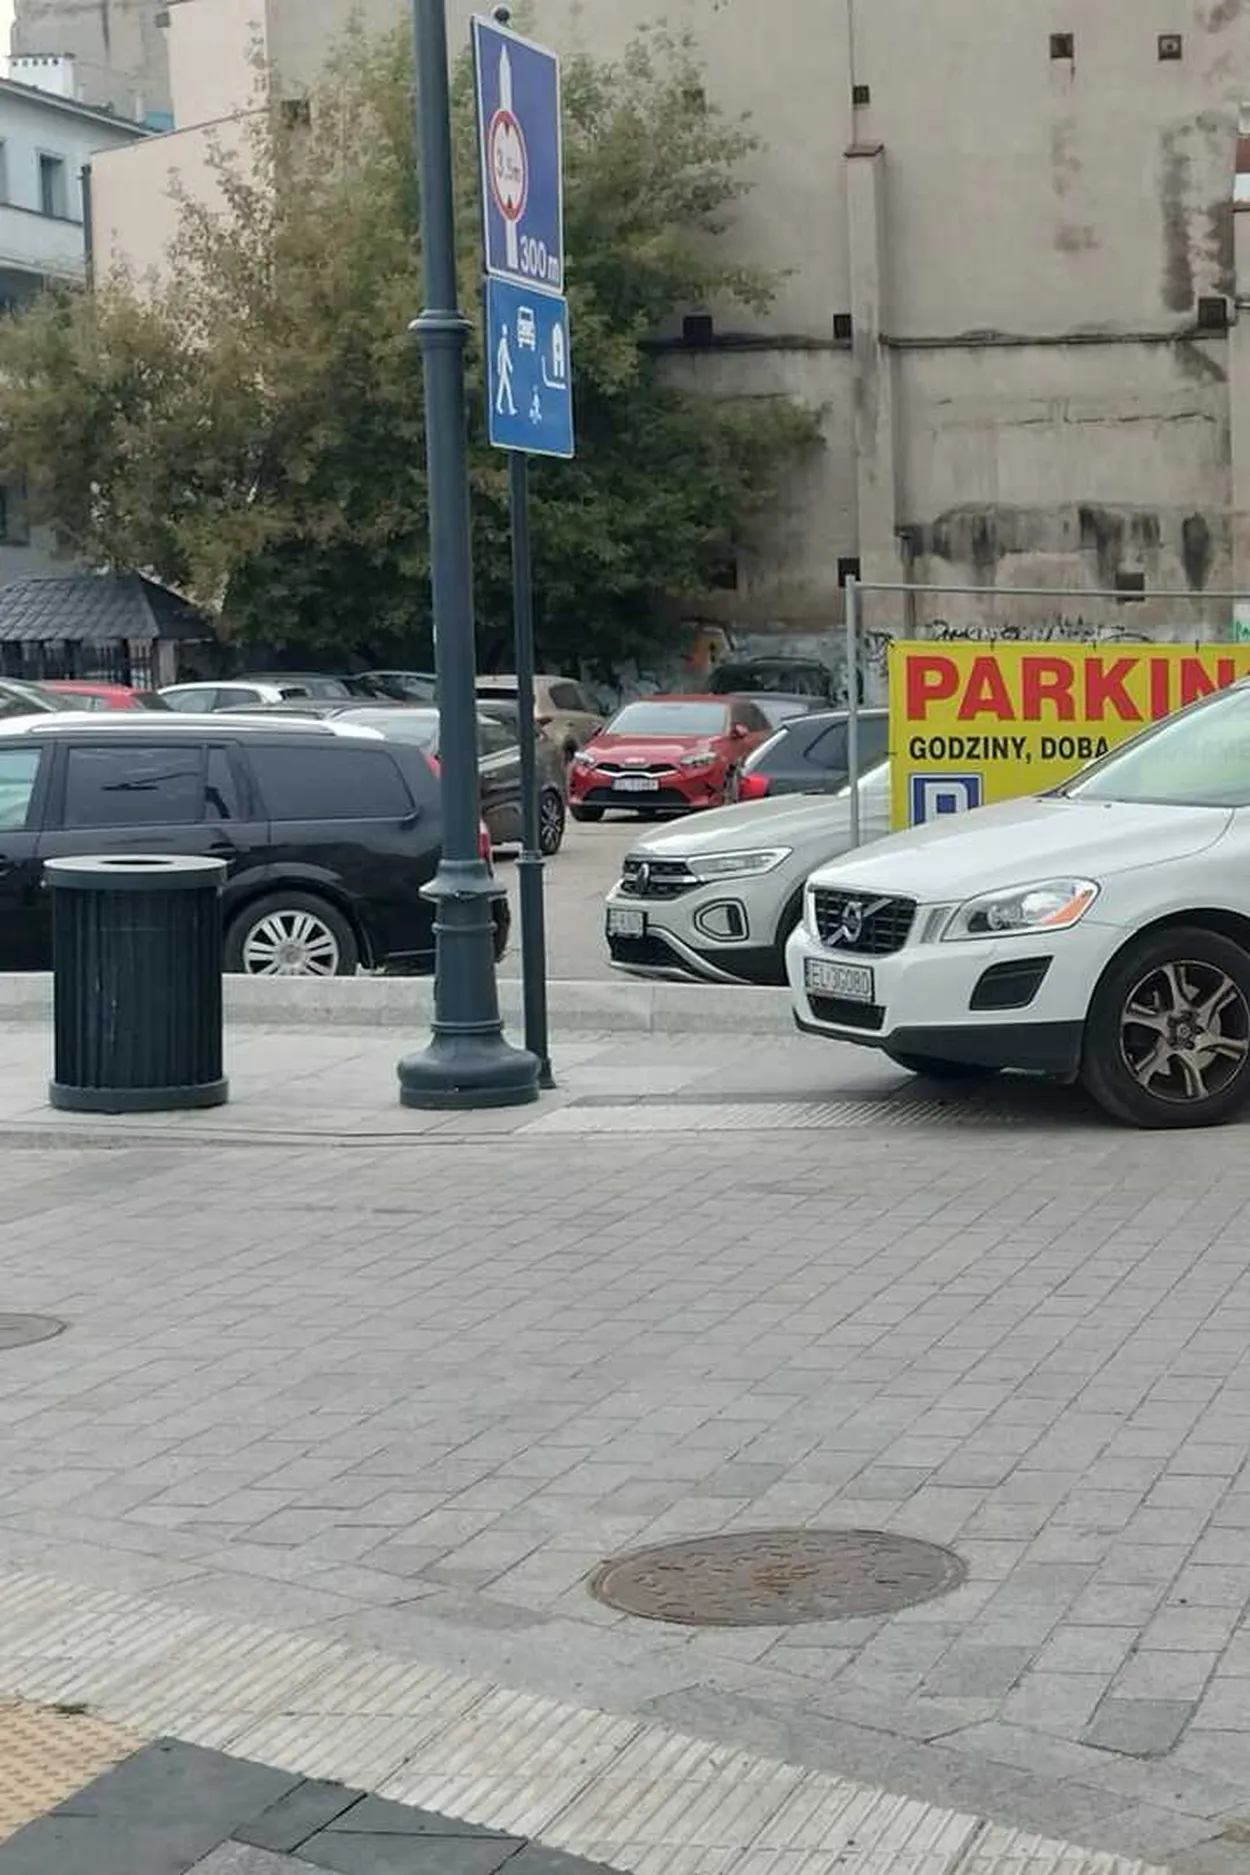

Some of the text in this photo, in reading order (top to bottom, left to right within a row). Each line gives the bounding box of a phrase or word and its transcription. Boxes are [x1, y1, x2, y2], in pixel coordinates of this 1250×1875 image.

[519, 235, 560, 283] 300 m
[909, 736, 1033, 765] GODZINY,
[1040, 736, 1109, 761] DOBA
